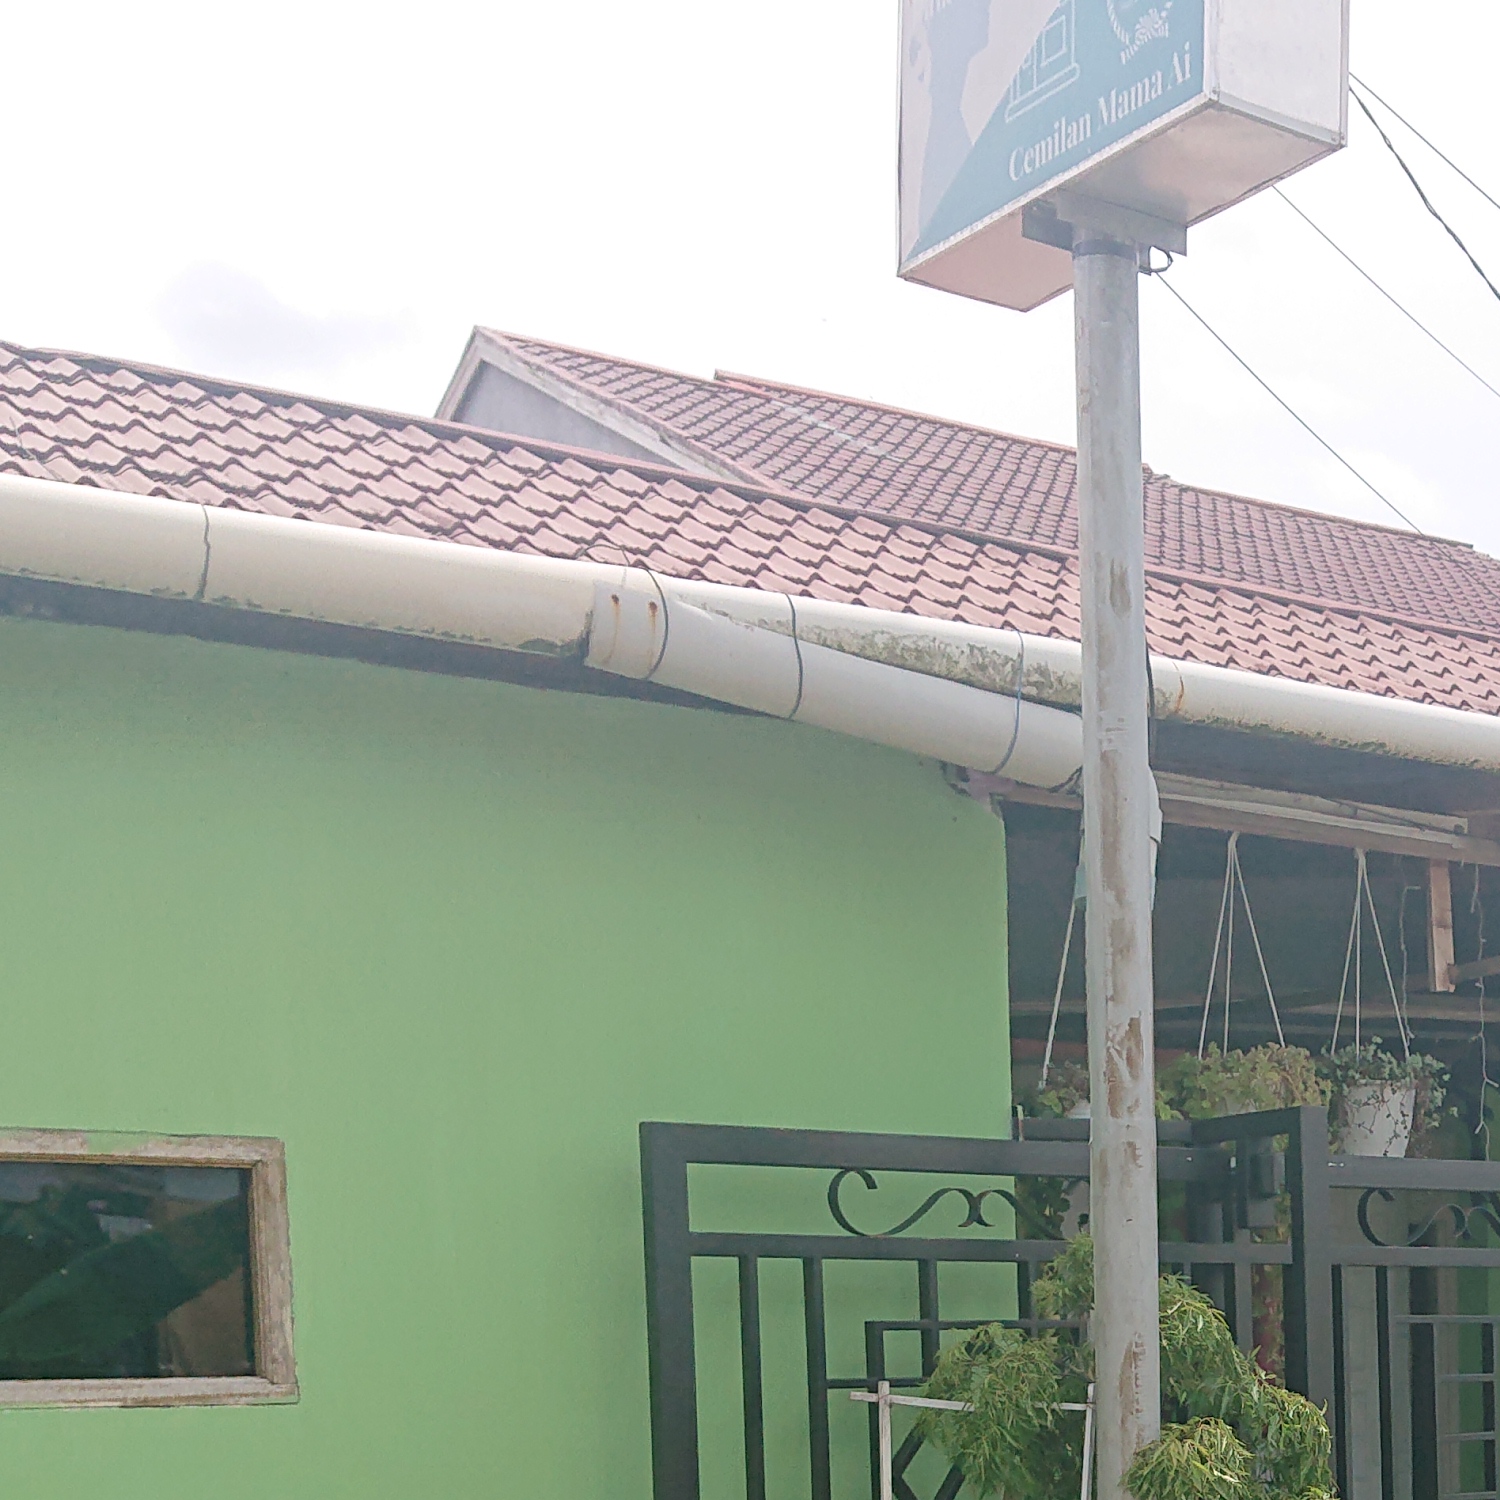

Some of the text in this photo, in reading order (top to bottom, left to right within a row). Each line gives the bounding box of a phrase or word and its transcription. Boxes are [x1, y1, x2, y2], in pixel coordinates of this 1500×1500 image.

[1009, 41, 1191, 181] Cemilan Mama Ai
